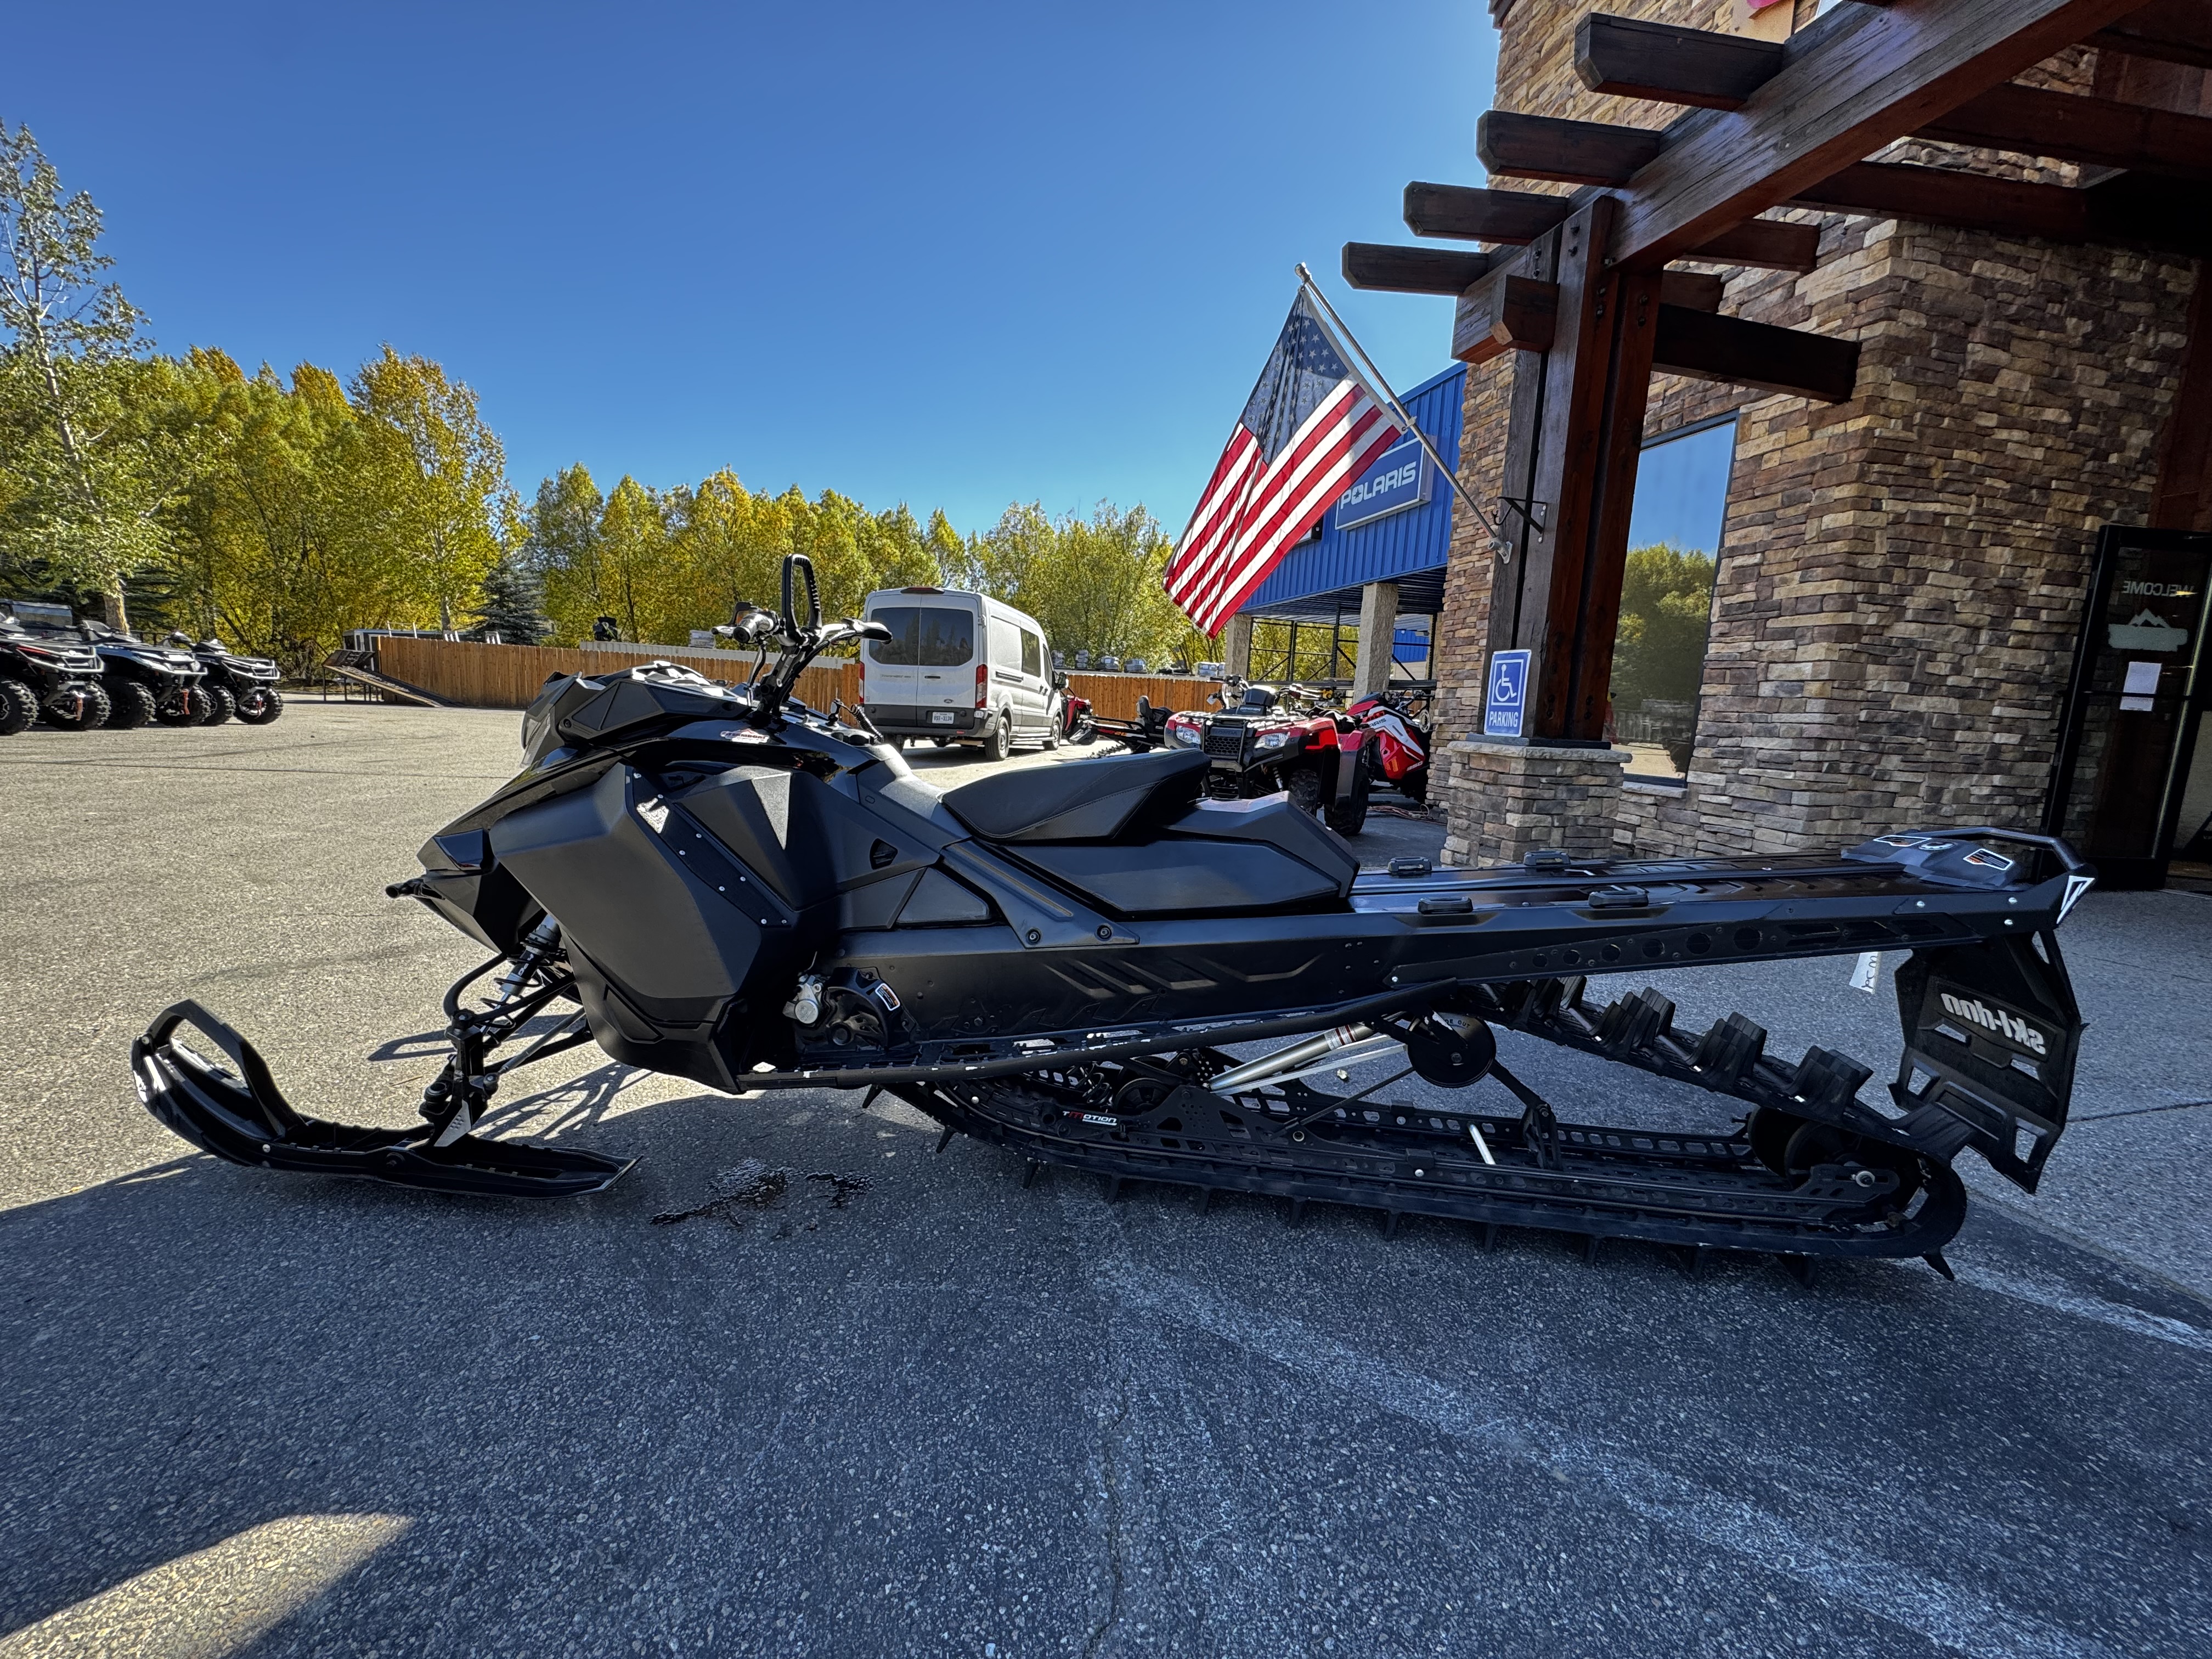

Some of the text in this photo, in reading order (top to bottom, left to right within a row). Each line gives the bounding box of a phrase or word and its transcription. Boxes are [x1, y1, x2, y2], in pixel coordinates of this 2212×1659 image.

[1340, 461, 1417, 510] POLARIS
[1488, 711, 1519, 727] PARKING
[1458, 1020, 1471, 1028] OUT
